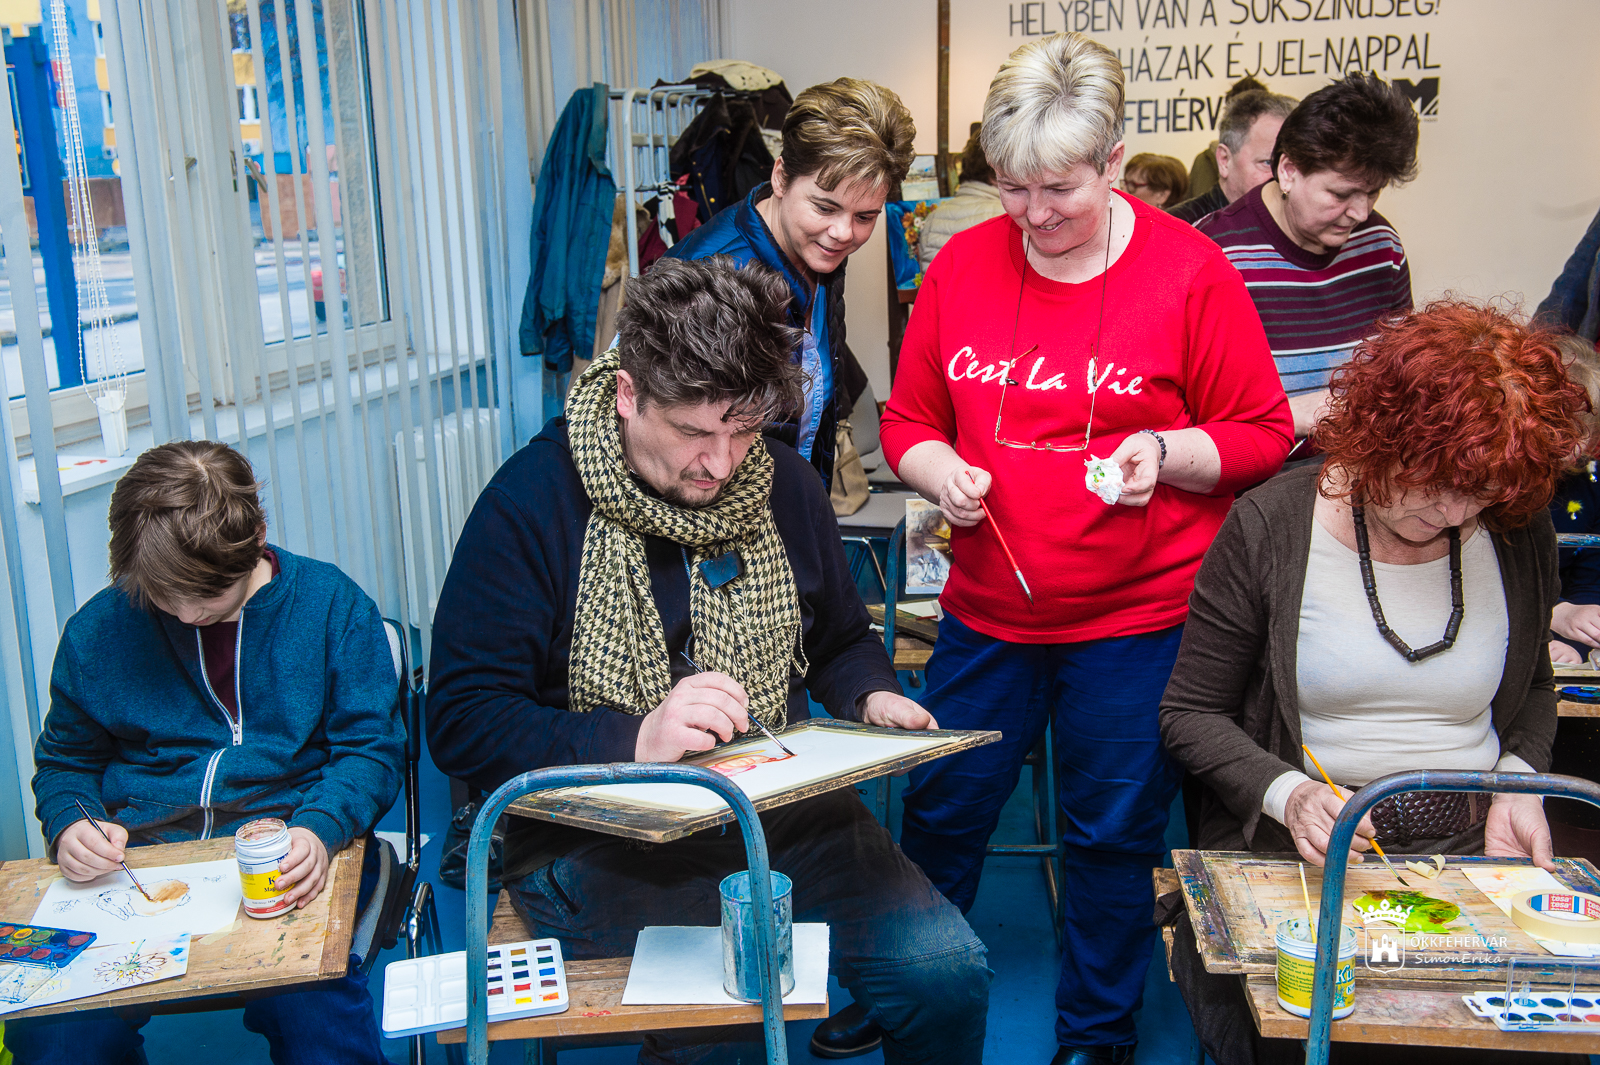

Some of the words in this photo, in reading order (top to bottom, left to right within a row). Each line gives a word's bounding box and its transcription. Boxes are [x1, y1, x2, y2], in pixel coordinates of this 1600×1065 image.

[1009, 0, 1124, 36] HELYBEN
[1135, 0, 1189, 30] VAN
[1199, 0, 1218, 27] A
[1117, 36, 1214, 82] HÁZAK
[1226, 31, 1441, 79] ÉJJEL-NAPPAL
[1122, 88, 1223, 134] FEHÉRV
[947, 346, 1017, 386] C'est
[1025, 356, 1067, 391] La
[1087, 357, 1143, 395] Vie
